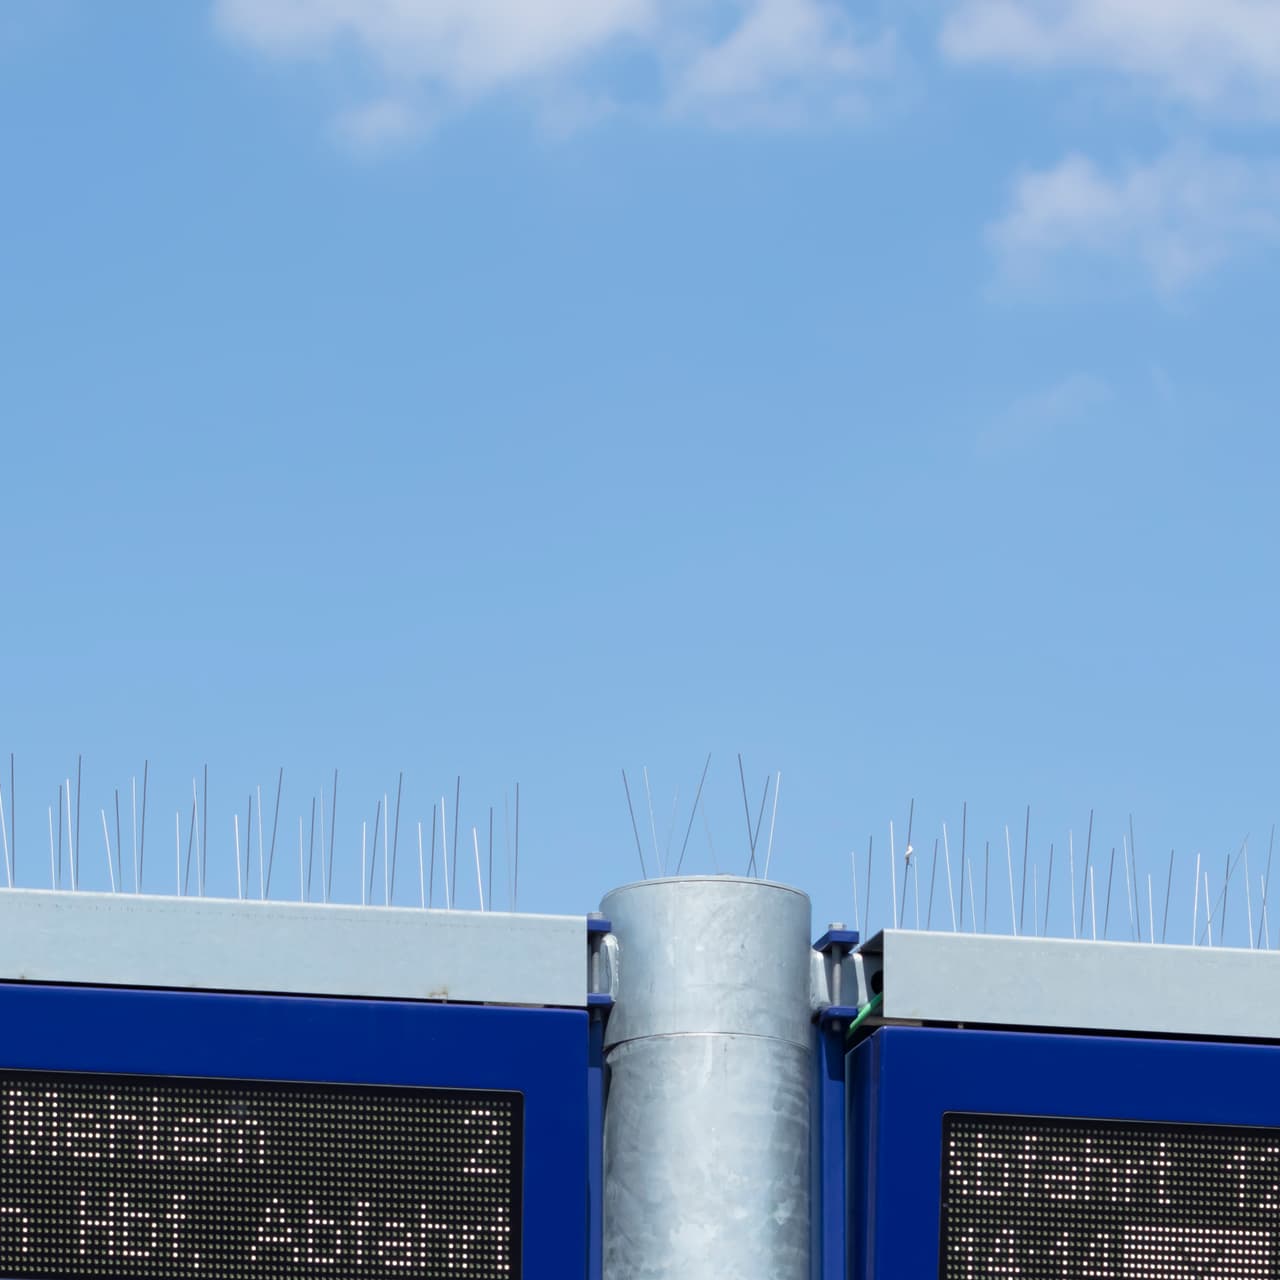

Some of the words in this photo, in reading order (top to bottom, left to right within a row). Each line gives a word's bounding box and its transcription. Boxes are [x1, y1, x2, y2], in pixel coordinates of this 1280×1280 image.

[463, 1109, 497, 1173] 2
[79, 1189, 200, 1268] Hbf,
[250, 1197, 510, 1270] Abfahrt
